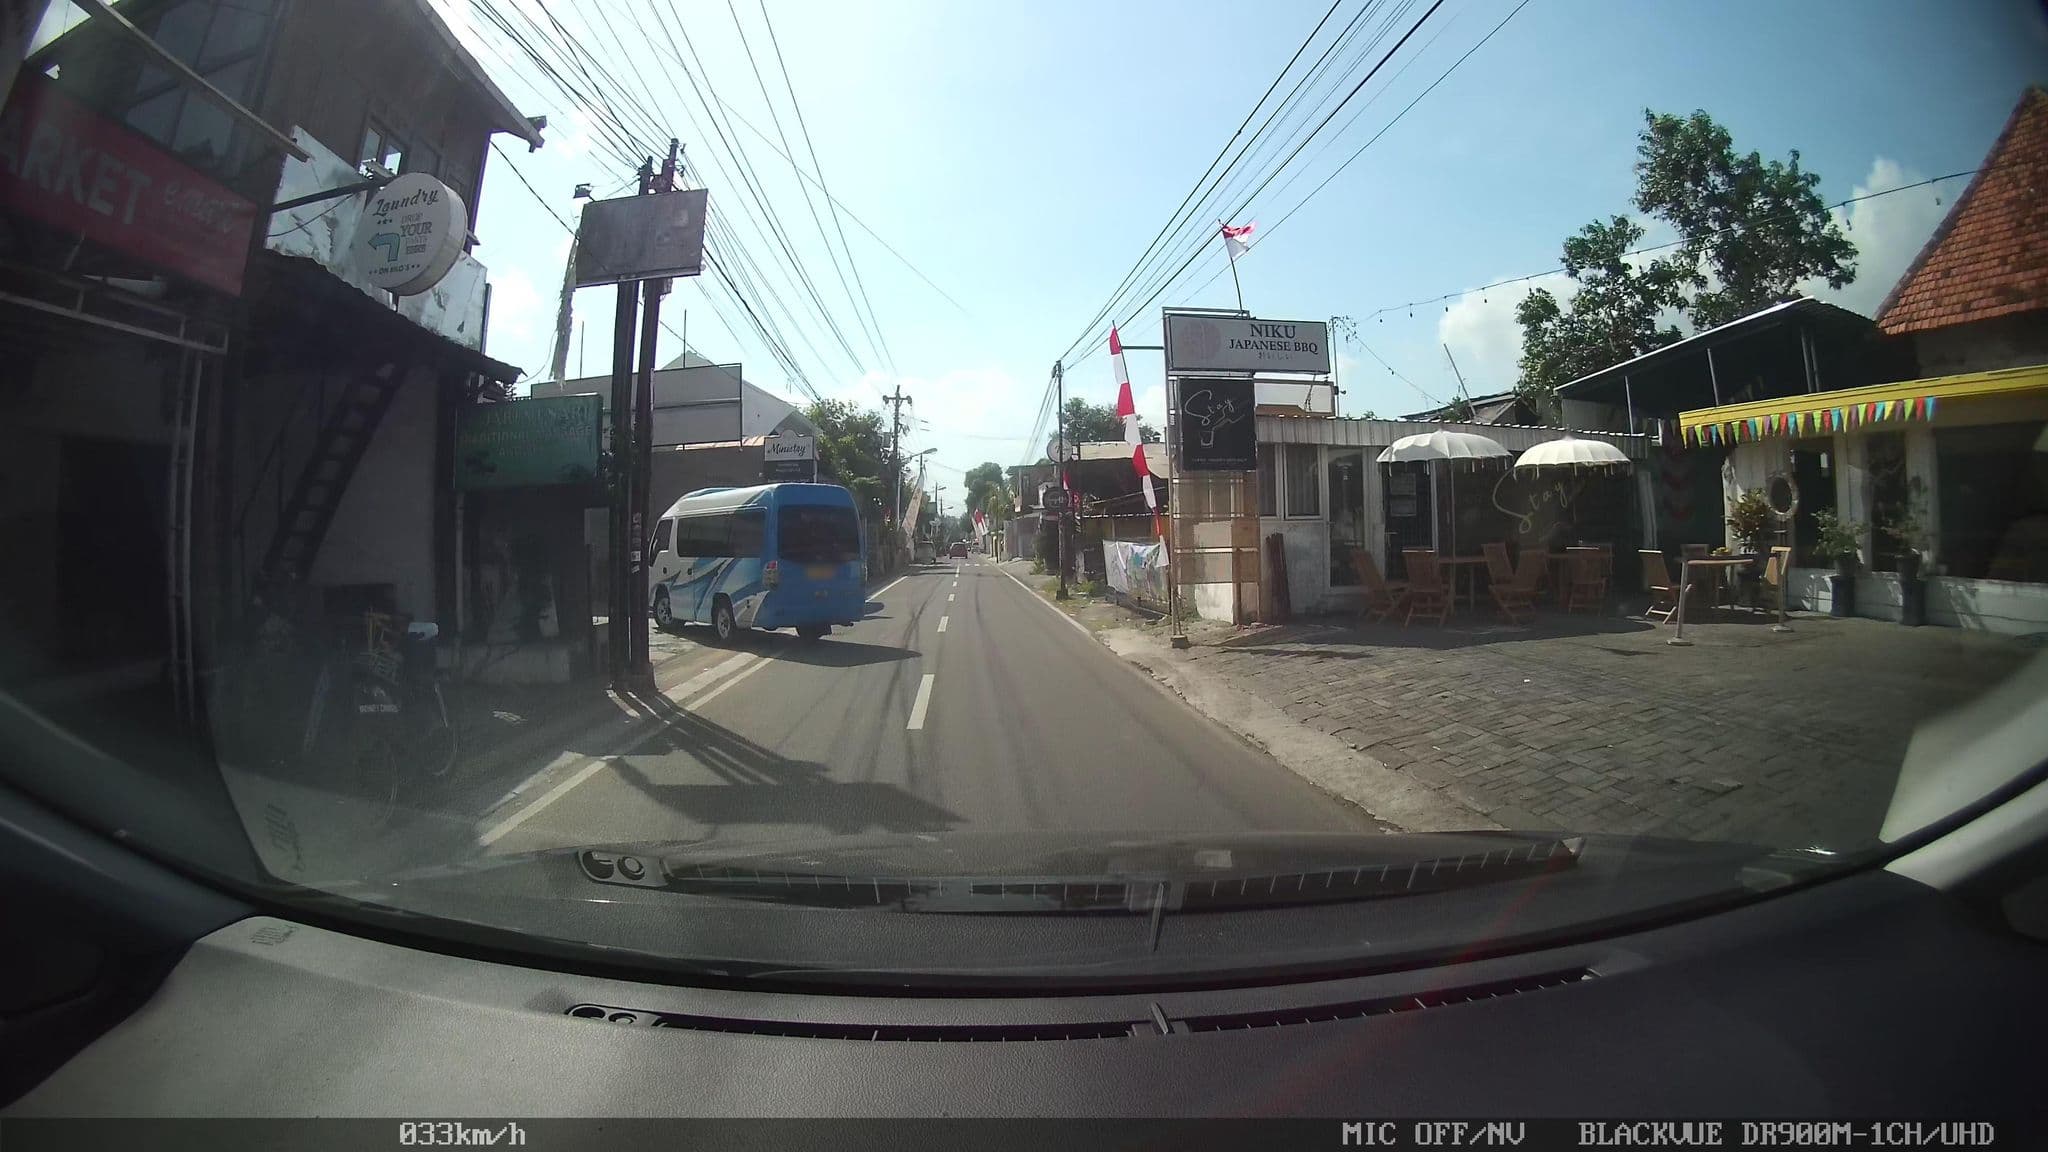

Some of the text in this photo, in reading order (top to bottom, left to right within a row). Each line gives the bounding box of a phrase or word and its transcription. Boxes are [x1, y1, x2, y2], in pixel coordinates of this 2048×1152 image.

[372, 188, 440, 217] Laundry
[400, 222, 433, 237] YOUR
[1249, 324, 1297, 339] NIKU
[1229, 339, 1319, 354] JAPANESE BBQ
[1185, 389, 1235, 426] Stay
